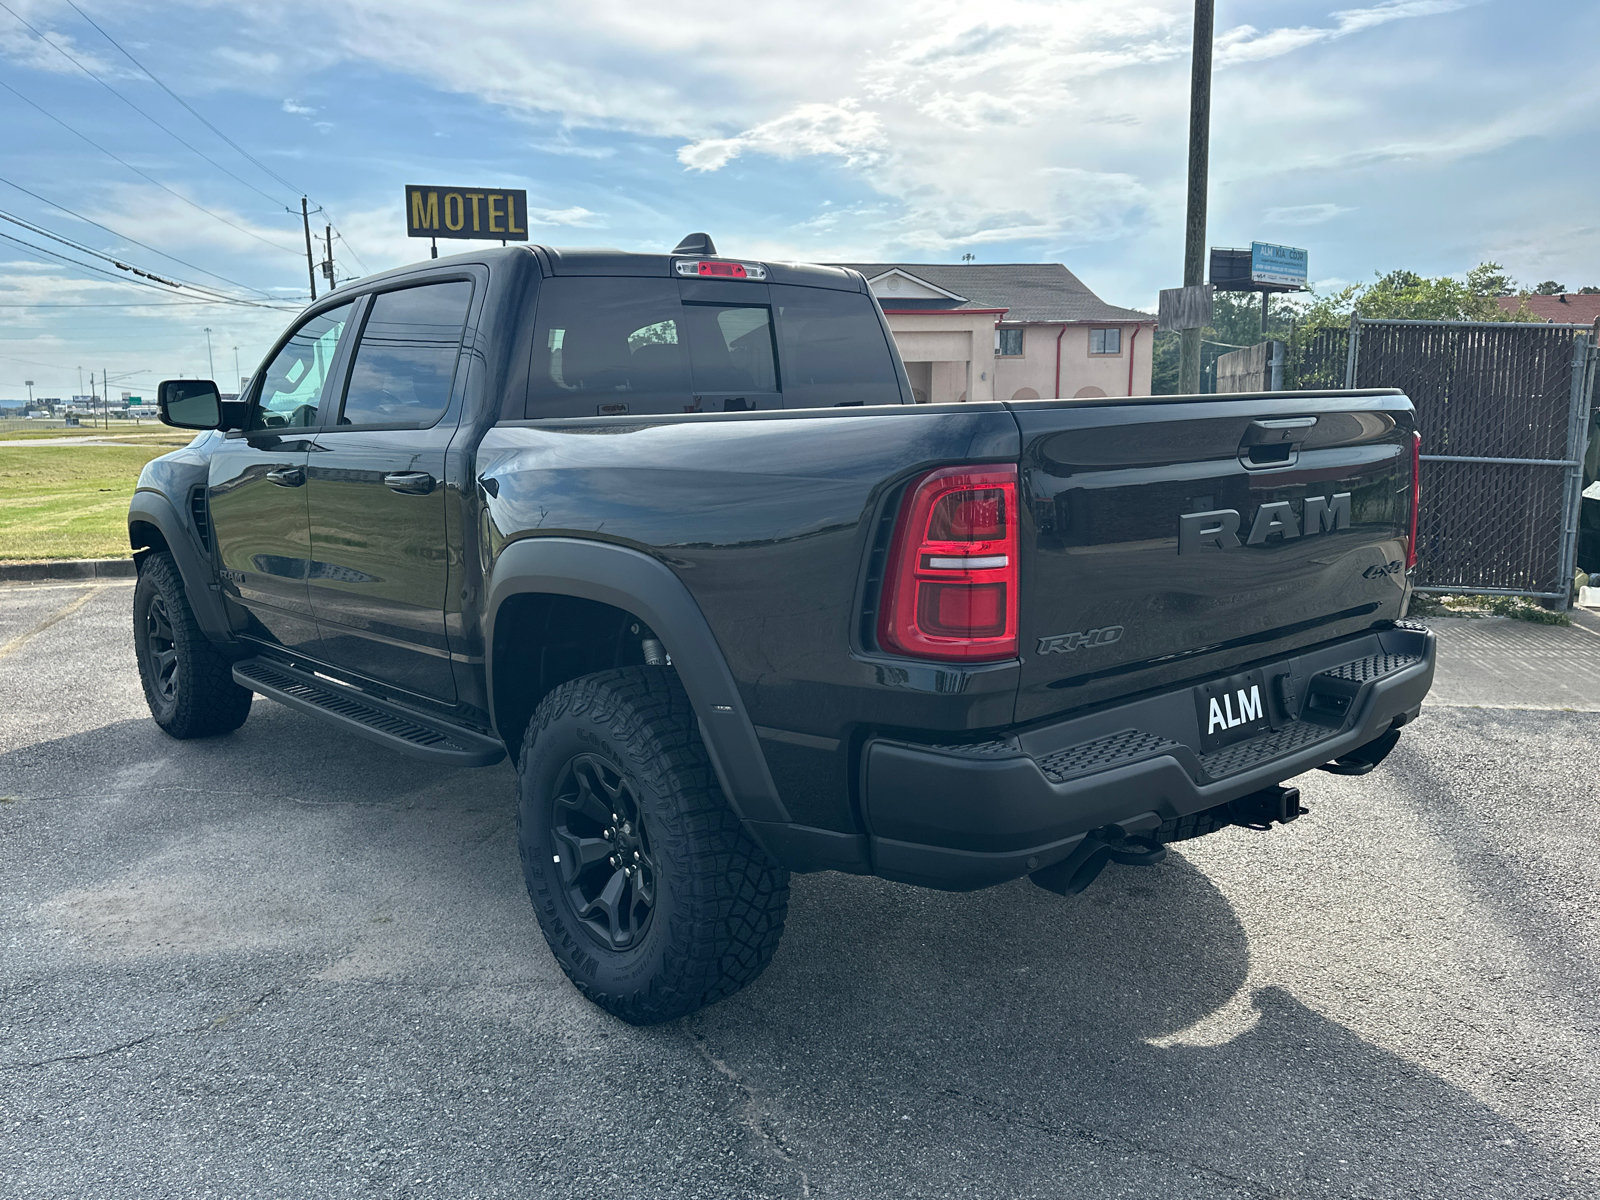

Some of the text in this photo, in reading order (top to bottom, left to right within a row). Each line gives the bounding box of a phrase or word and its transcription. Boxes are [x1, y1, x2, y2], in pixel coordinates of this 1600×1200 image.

[411, 191, 525, 233] MOTEL
[1260, 246, 1273, 257] ALM
[1177, 492, 1351, 555] RAM
[1035, 625, 1125, 656] RHO
[1208, 685, 1263, 735] ALM
